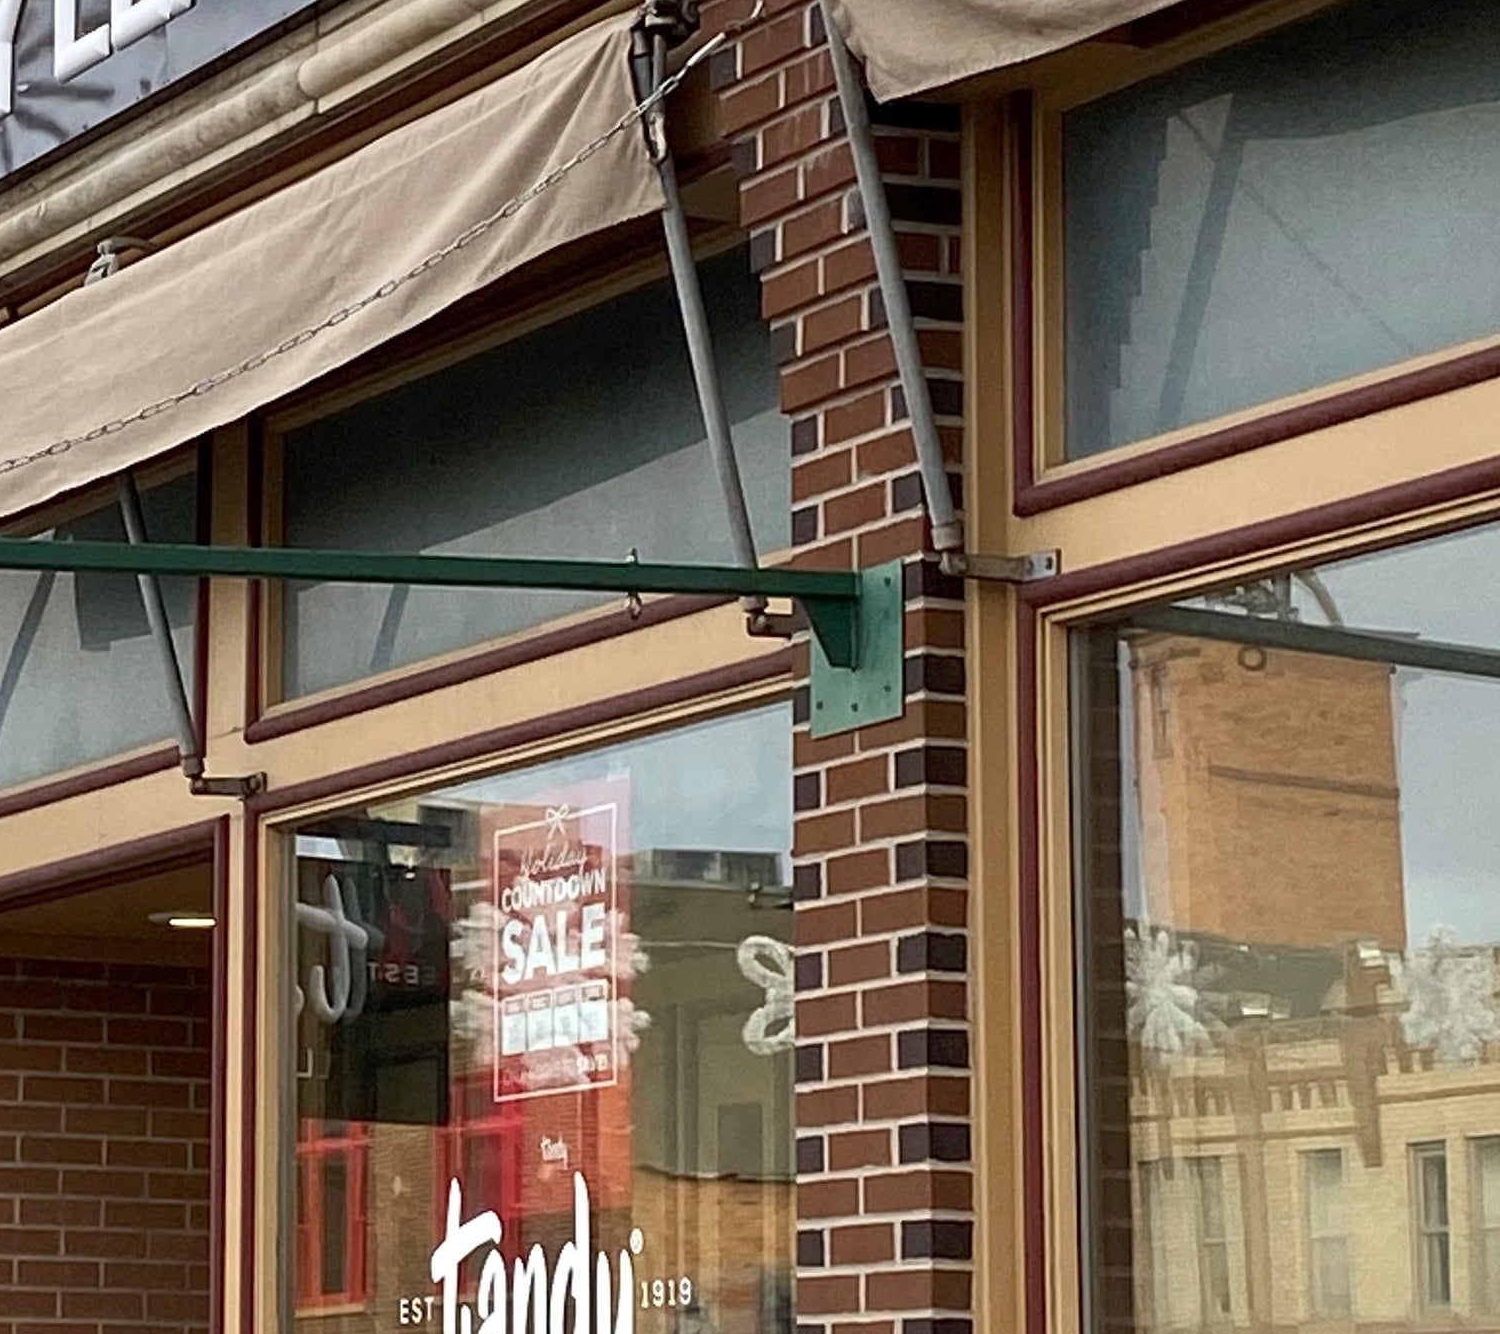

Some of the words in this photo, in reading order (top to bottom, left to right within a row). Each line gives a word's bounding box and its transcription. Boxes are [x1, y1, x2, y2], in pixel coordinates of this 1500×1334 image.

[520, 839, 588, 880] Holiday
[501, 866, 606, 913] COUNTDOWN
[501, 901, 606, 985] SALE
[399, 1296, 435, 1325] EST
[639, 1276, 692, 1310] 1919
